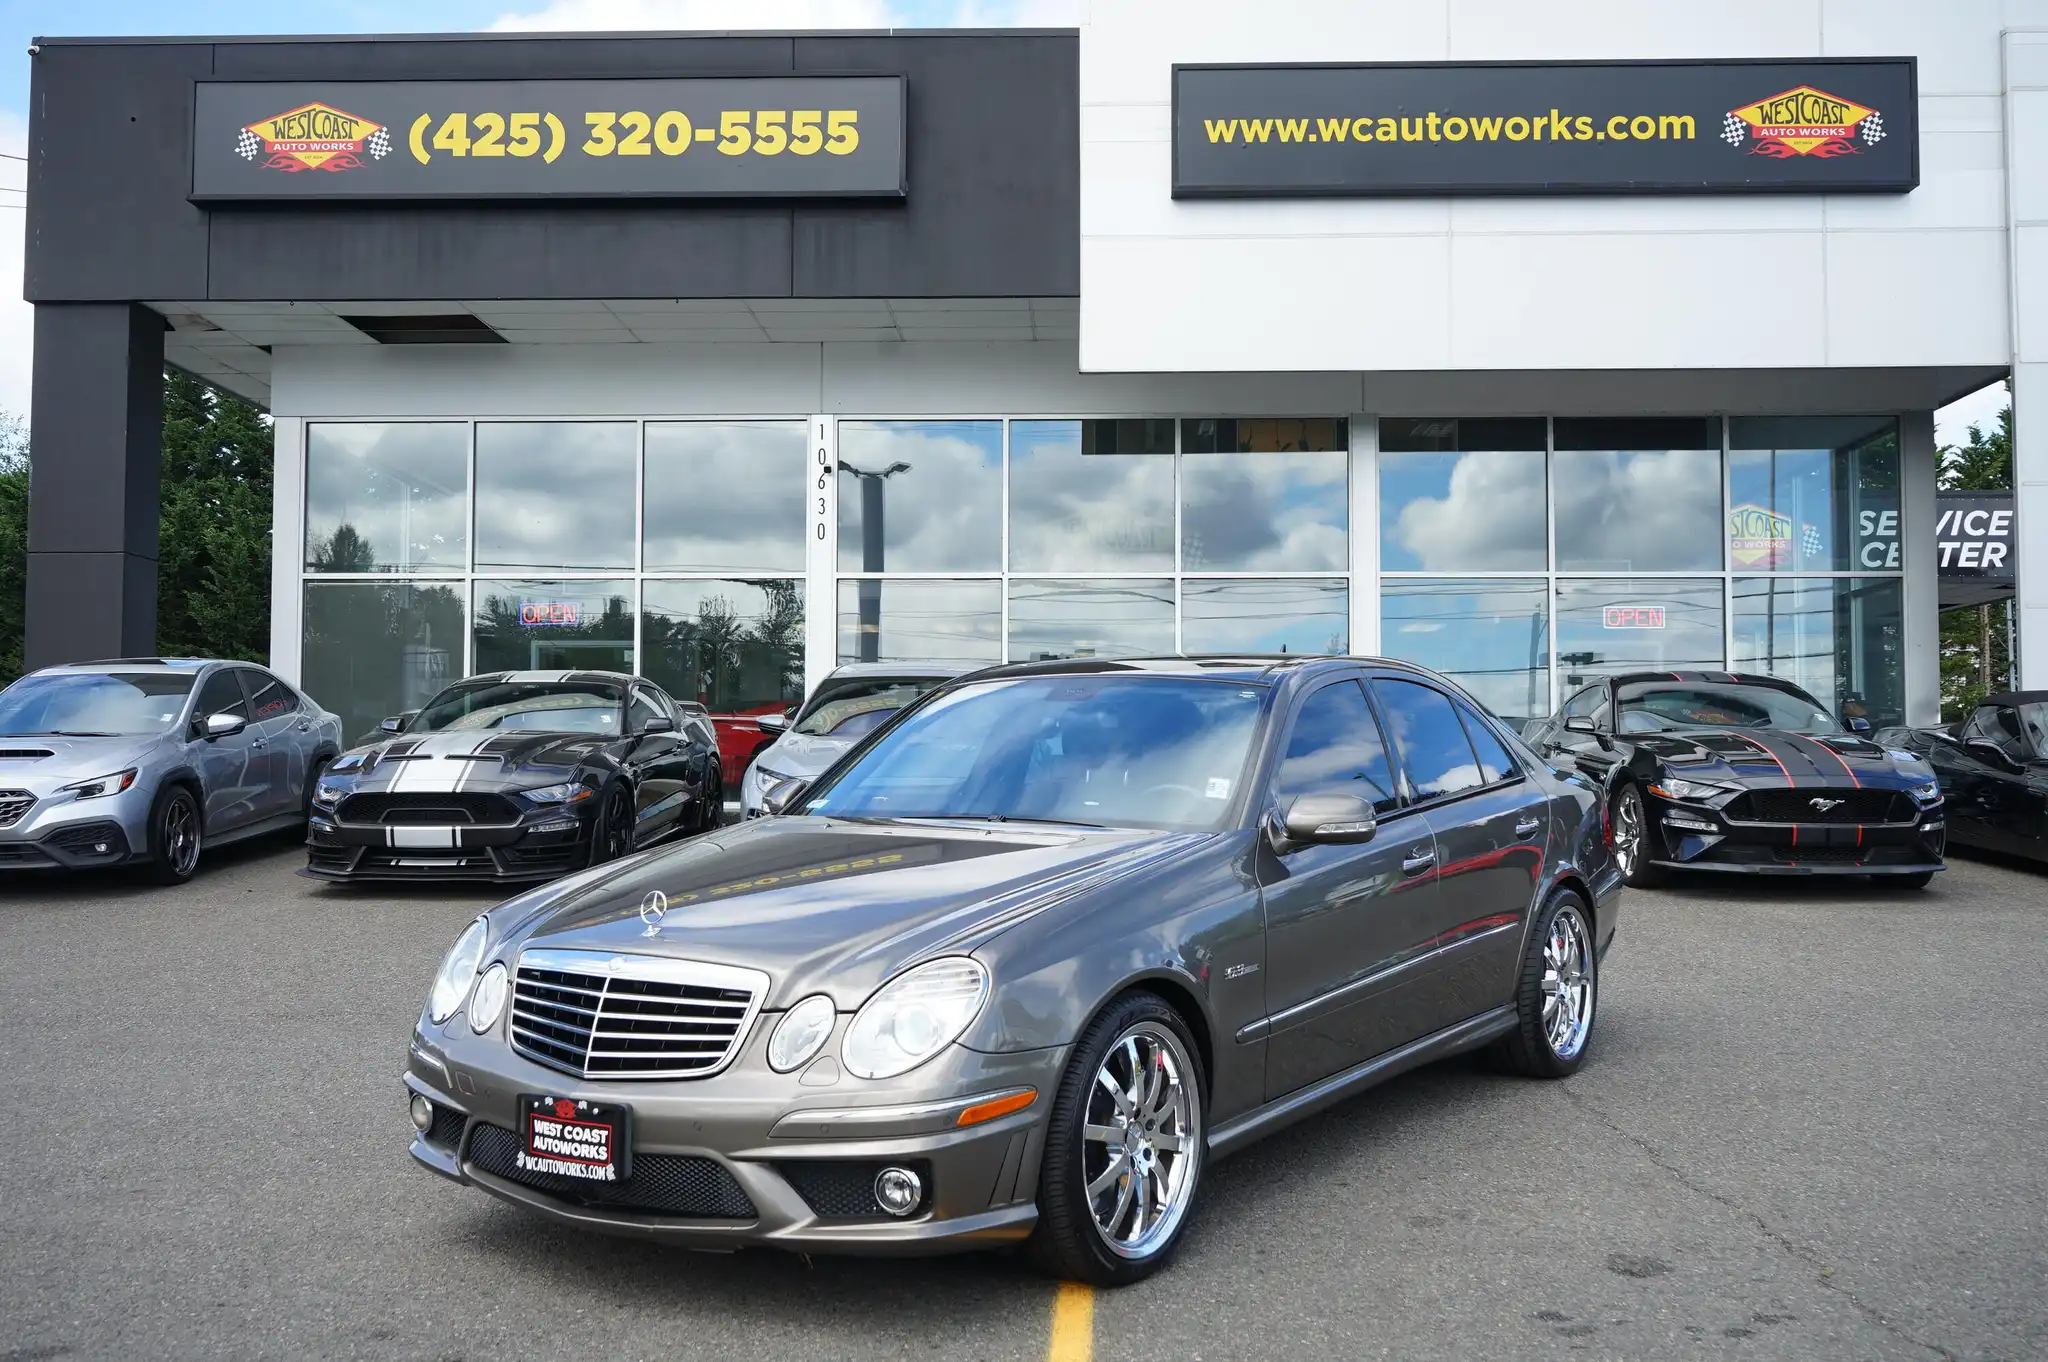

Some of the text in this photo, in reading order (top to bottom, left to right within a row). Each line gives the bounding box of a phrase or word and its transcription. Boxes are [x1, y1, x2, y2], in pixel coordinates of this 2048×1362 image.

[409, 110, 859, 165] (425) 320-5555
[1204, 109, 1696, 143] www.wcautoworks.com
[1760, 127, 1845, 136] AUTO WORKS
[273, 142, 354, 151] AUTO WORKS
[1744, 540, 1786, 549] WORKS
[1860, 541, 2007, 567] CETER
[522, 604, 576, 623] OPEN
[1607, 608, 1663, 626] OPEN
[533, 1119, 608, 1144] WEST COAST
[533, 1135, 608, 1160] AUTOWORKS
[525, 1155, 606, 1181] WCAUTOWORKS.COM
